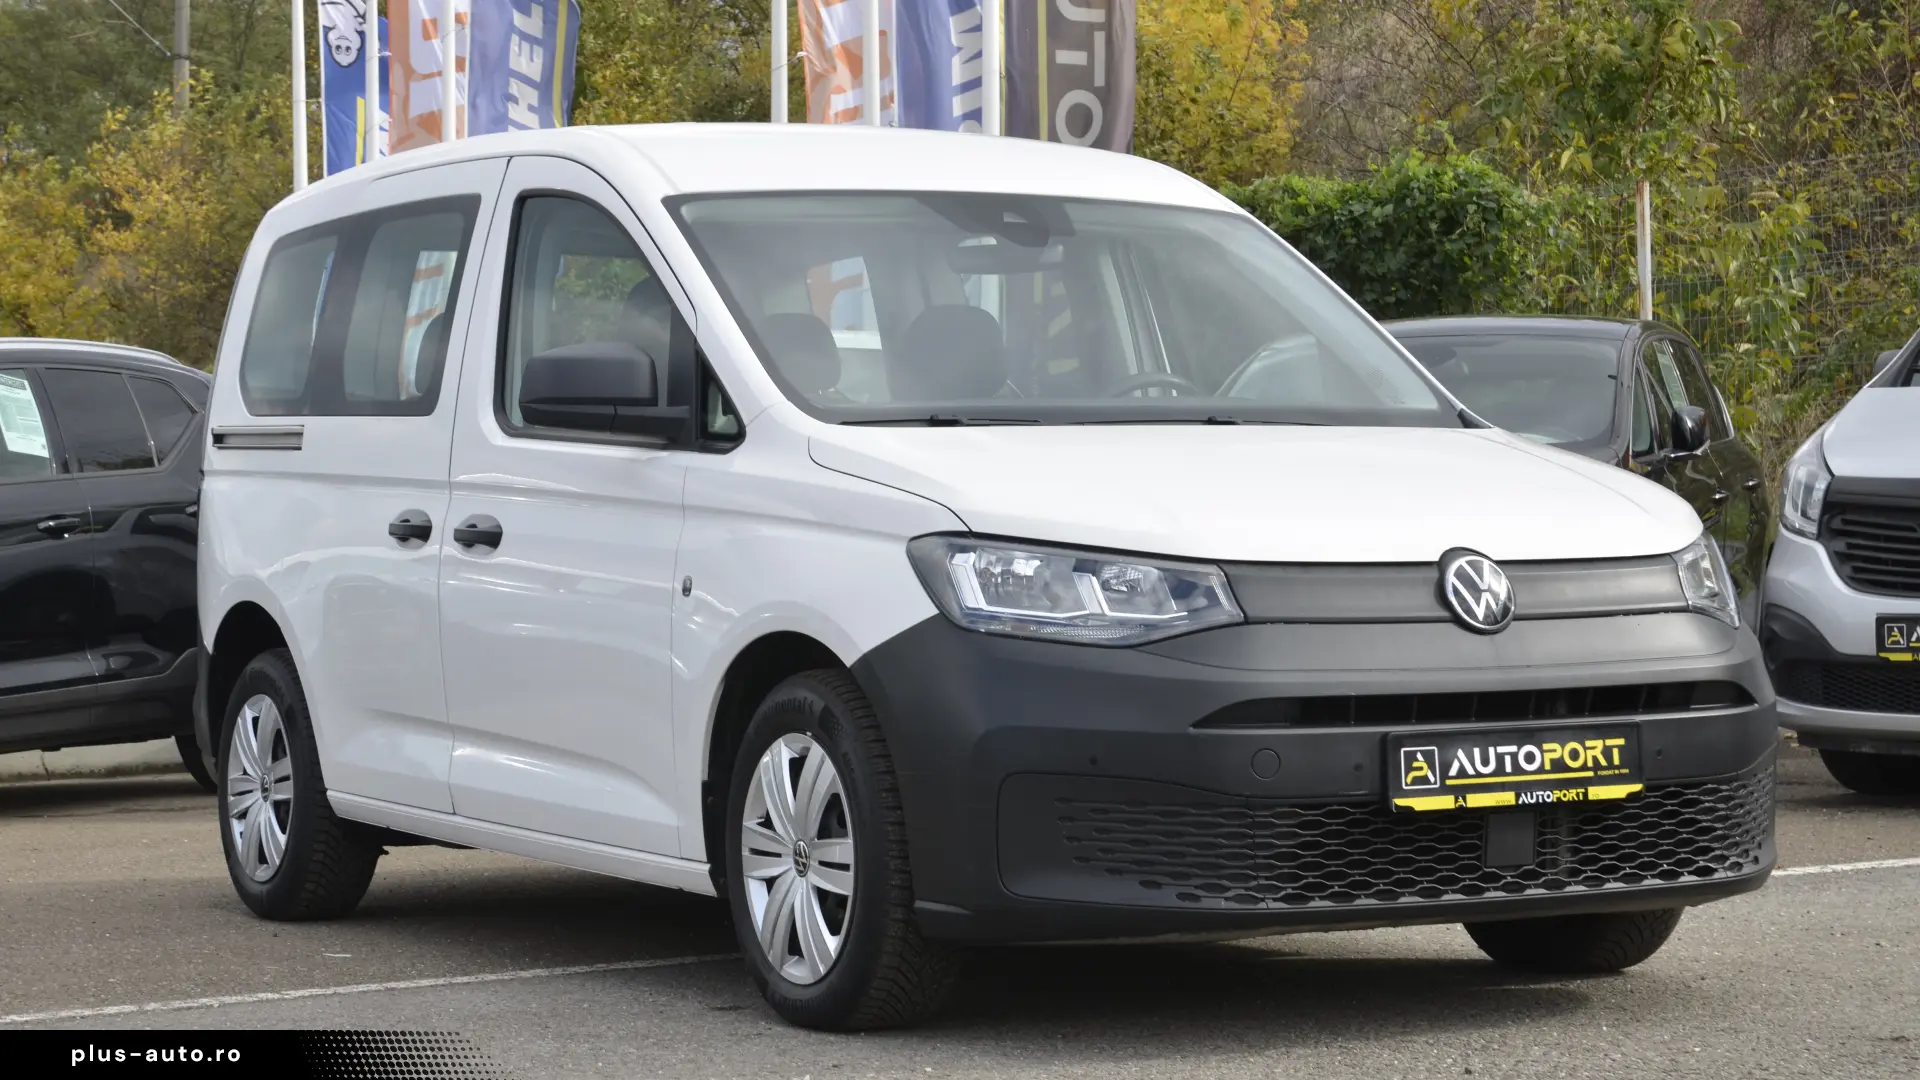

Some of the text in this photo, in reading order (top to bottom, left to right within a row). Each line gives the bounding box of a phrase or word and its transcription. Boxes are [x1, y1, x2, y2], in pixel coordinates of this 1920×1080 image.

[508, 2, 543, 132] HEL
[1448, 738, 1625, 776] AUTOPORT
[1518, 789, 1586, 804] AUTOPORT
